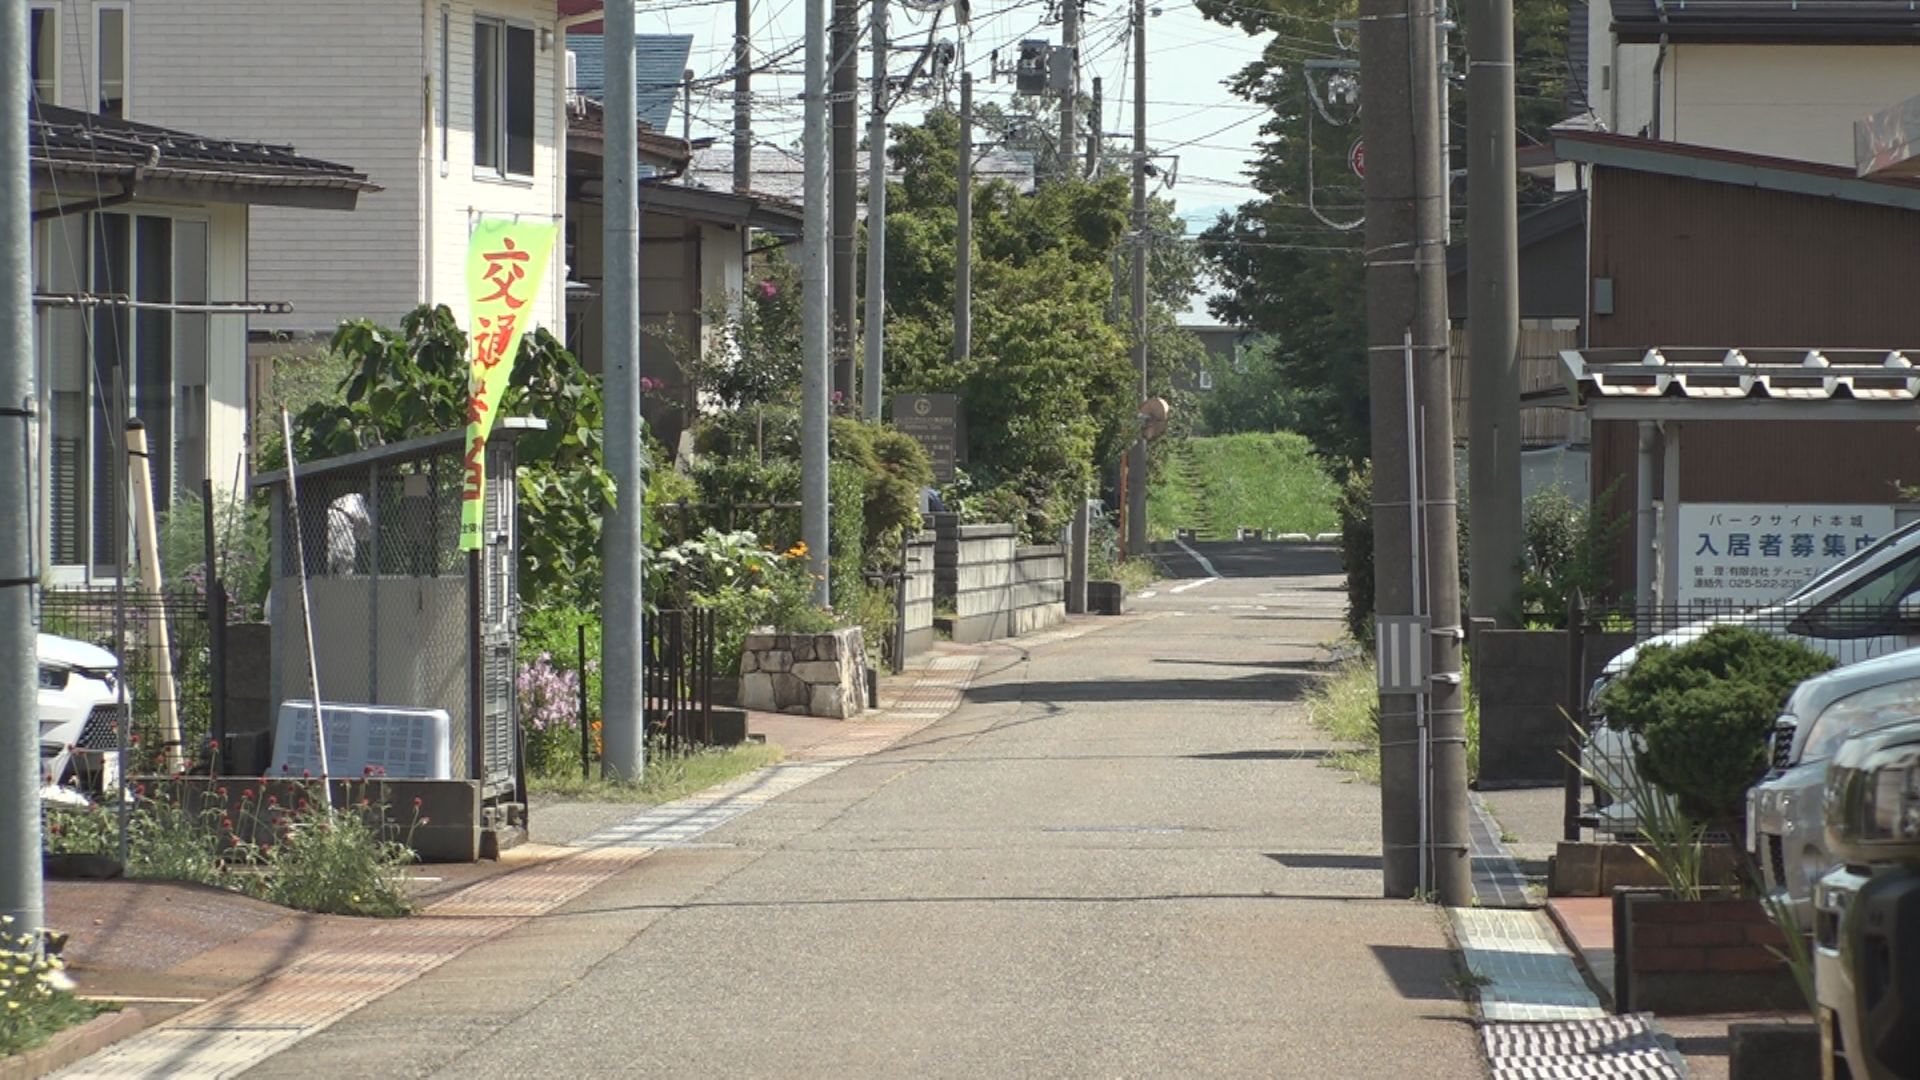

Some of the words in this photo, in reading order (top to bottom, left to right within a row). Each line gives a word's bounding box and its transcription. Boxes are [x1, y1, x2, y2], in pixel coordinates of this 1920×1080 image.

[1709, 513, 1864, 528] パークサイド本城
[1695, 533, 1878, 557] 入居者募集中
